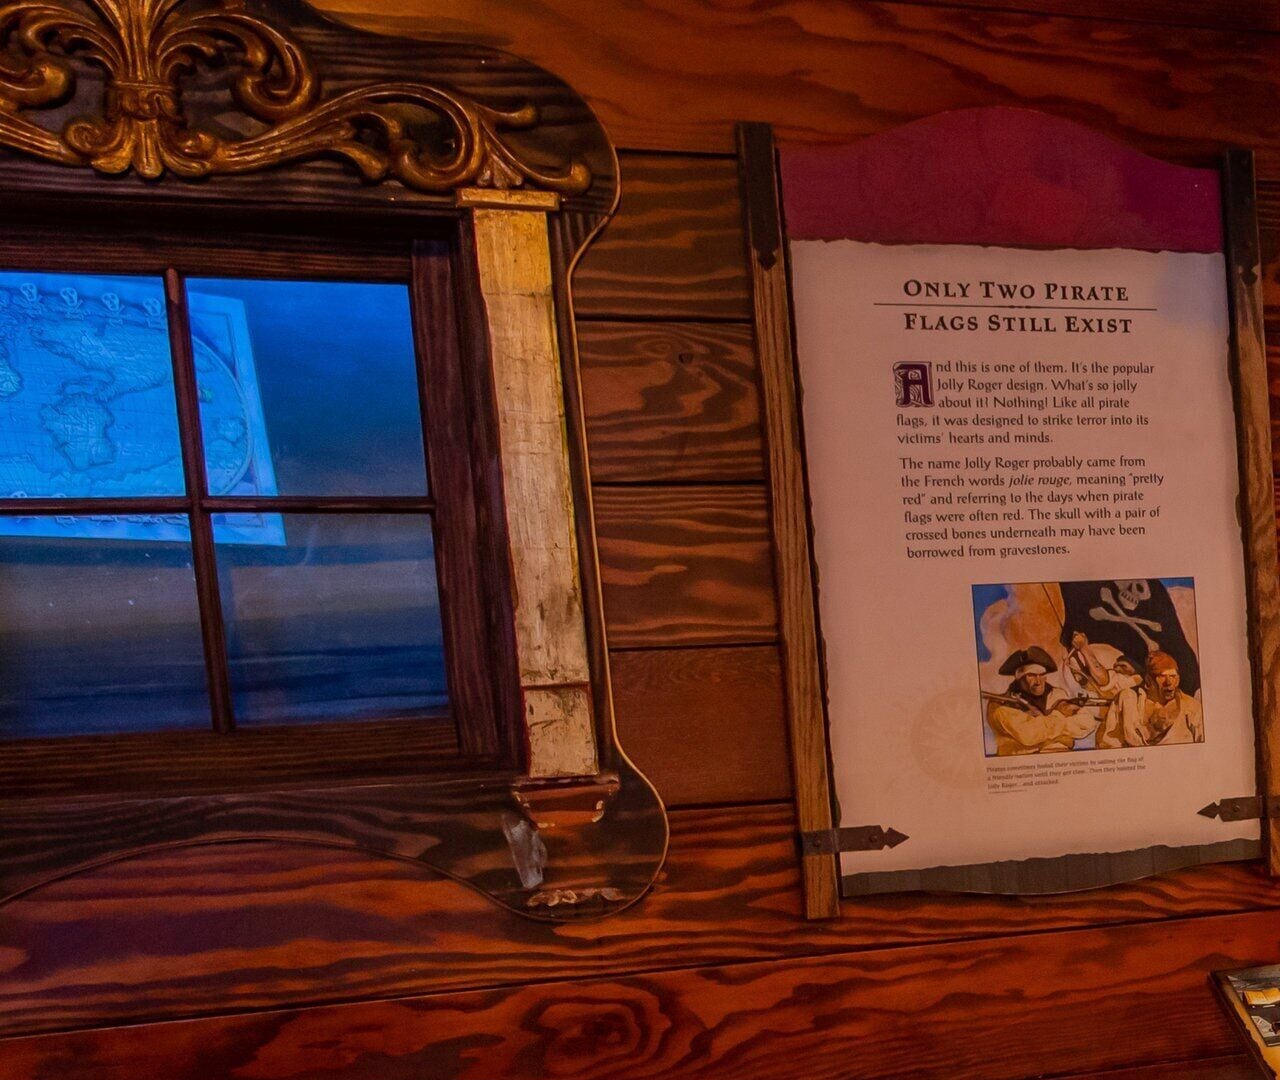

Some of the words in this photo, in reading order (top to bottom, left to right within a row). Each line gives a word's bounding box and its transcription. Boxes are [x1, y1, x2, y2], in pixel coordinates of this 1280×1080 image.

[903, 280, 970, 297] ONLY
[979, 281, 1034, 299] TWO
[1044, 283, 1128, 301] PIRATE
[904, 313, 977, 331] FLAGS
[988, 314, 1056, 332] STILL
[1064, 316, 1131, 333] EXIST
[955, 360, 976, 372] this
[981, 362, 989, 372] is
[994, 364, 1015, 372] one
[1019, 361, 1029, 372] of
[1034, 361, 1066, 373] them.
[1091, 361, 1108, 373] the
[1113, 362, 1154, 376] popular
[937, 378, 963, 392] Jolly
[968, 378, 1002, 393] Roger
[1006, 378, 1046, 393] design.
[1097, 382, 1108, 390] so
[1113, 379, 1137, 393] jolly
[938, 396, 971, 408] about
[993, 396, 1047, 410] Nothing!
[1053, 396, 1076, 408] Like
[1081, 396, 1094, 408] all
[1099, 397, 1129, 410] pirate
[896, 413, 927, 428] flags,
[932, 415, 939, 425] it
[944, 417, 968, 425] was
[972, 413, 1023, 428] designed
[1028, 415, 1038, 425] to
[1042, 413, 1072, 425] strike
[1076, 415, 1107, 425] terror
[1111, 415, 1132, 425] into
[1136, 414, 1148, 425] its
[949, 431, 984, 443] hearts
[988, 431, 1009, 443] and
[1014, 431, 1052, 442] minds.
[899, 457, 923, 469] The
[928, 460, 960, 469] name
[964, 457, 990, 470] Jolly
[995, 457, 1029, 470] Roger
[1033, 455, 1083, 470] probably
[1087, 459, 1115, 467] came
[1120, 455, 1145, 466] from
[901, 475, 919, 487] the
[924, 475, 964, 486] French
[968, 474, 1004, 486] words
[1008, 474, 1034, 488] jolie
[1038, 476, 1071, 487] rouge,
[1076, 474, 1125, 486] meaning
[930, 492, 952, 504] and
[957, 492, 1006, 506] referring
[1010, 493, 1021, 503] to
[1025, 491, 1043, 502] the
[1047, 490, 1072, 504] days
[1076, 490, 1108, 501] when
[1113, 491, 1143, 503] pirate
[904, 511, 931, 525] flags
[935, 513, 964, 522] were
[969, 509, 998, 521] often
[1003, 509, 1023, 520] red.
[1027, 508, 1050, 520] The
[1055, 507, 1080, 519] skull
[1084, 507, 1110, 518] with
[1115, 510, 1120, 518] a
[1125, 507, 1146, 520] pair
[1149, 505, 1160, 517] of
[905, 528, 947, 540] crossed
[951, 527, 986, 539] bones
[990, 525, 1055, 538] underneath
[1060, 528, 1084, 538] may
[1088, 524, 1115, 536] have
[1119, 523, 1145, 535] been
[907, 545, 964, 558] borrowed
[969, 545, 995, 556] from
[1000, 544, 1069, 558] gravestones.
